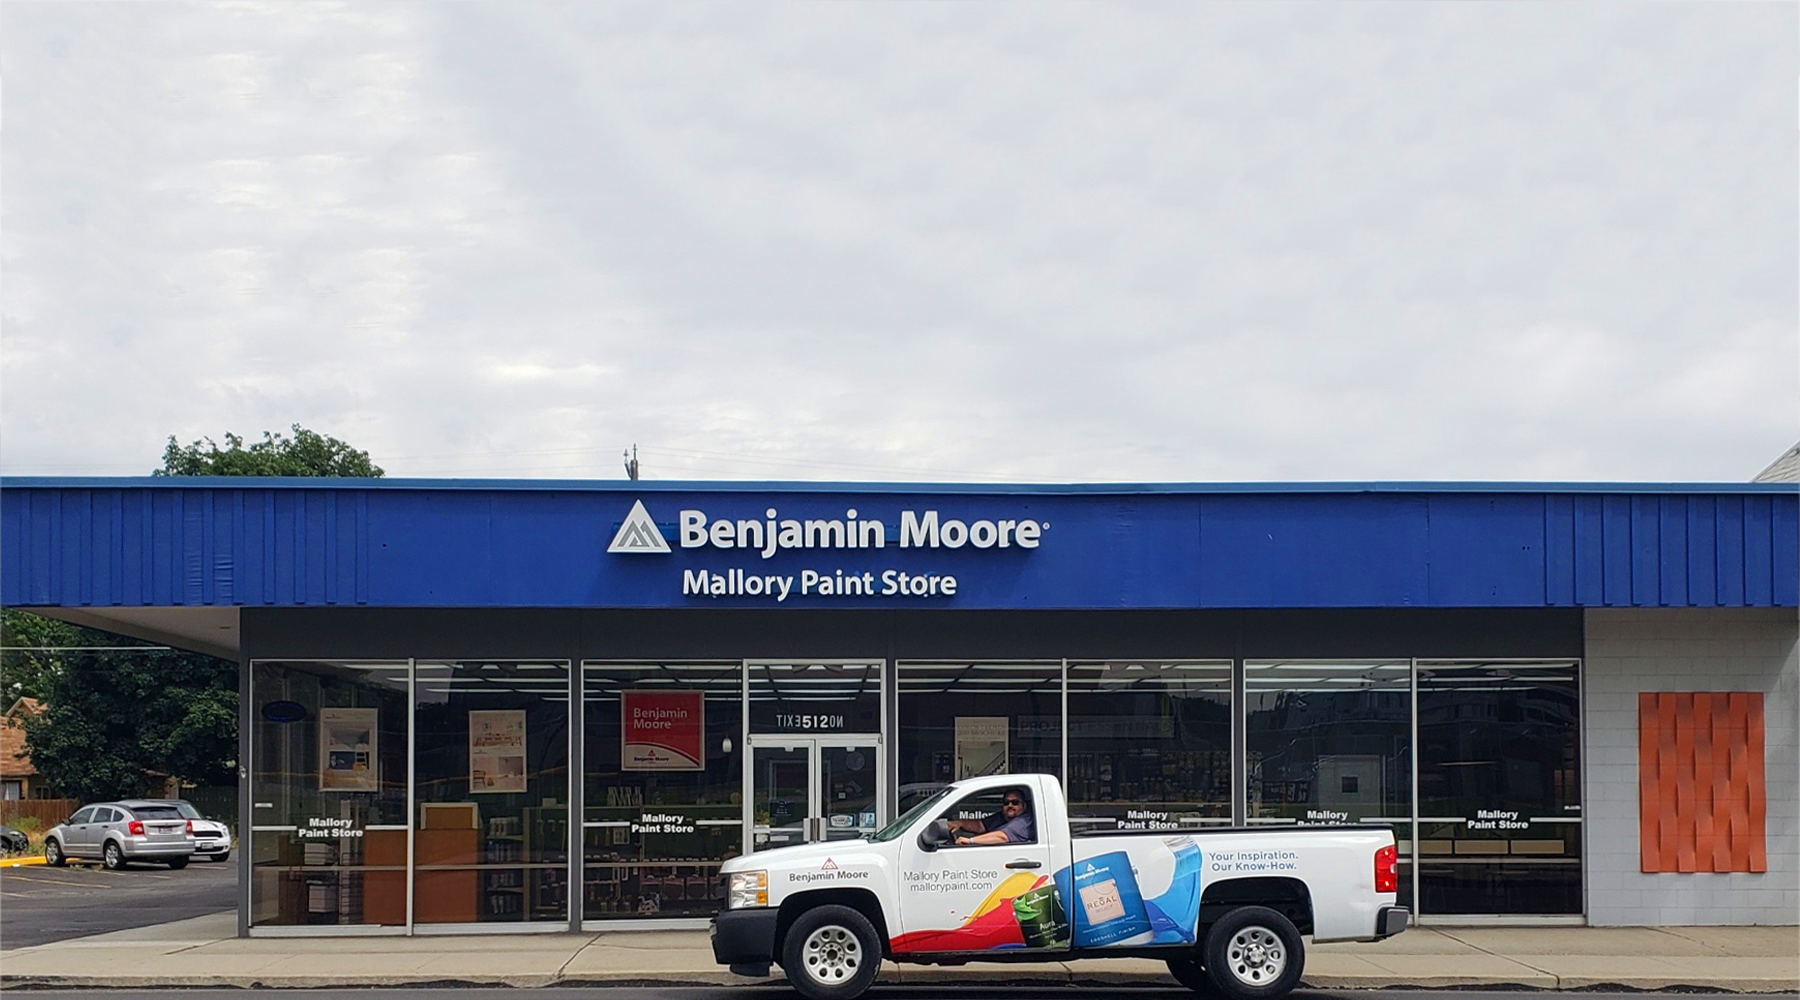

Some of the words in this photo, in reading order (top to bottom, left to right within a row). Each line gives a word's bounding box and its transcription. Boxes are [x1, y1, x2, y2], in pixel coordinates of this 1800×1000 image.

[679, 508, 885, 559] Benjamin
[900, 510, 1041, 549] Moore
[682, 569, 793, 601] Mallory
[801, 569, 875, 595] Paint
[881, 569, 958, 596] Store
[633, 707, 688, 720] Benjamin
[633, 719, 672, 729] Moore
[802, 715, 829, 729] 512
[1020, 720, 1084, 732] PROJCT
[642, 813, 684, 825] Mallory
[959, 810, 995, 820] Mallo
[1127, 810, 1168, 821] Mallory
[1307, 810, 1348, 821] Mallory
[1477, 809, 1519, 821] Mallory
[309, 817, 353, 829] Mallory
[631, 824, 661, 833] Paint
[663, 824, 694, 833] Store
[1117, 820, 1146, 829] Paint
[1148, 820, 1178, 830] Store
[1467, 820, 1496, 829] Paint
[1498, 820, 1529, 829] Store
[298, 828, 329, 838] Paint
[331, 828, 364, 837] Store
[1209, 852, 1234, 861] Your
[1237, 850, 1298, 861] Inspiration.
[1211, 862, 1232, 872] Our
[1235, 861, 1297, 871] Know-How.
[789, 870, 835, 882] Benjamin
[837, 869, 869, 880] Moore
[903, 871, 939, 882] Mallory
[942, 869, 968, 880] Paint
[970, 869, 998, 880] Store
[910, 881, 993, 893] mallorypaint.com
[1087, 896, 1117, 910] REGAL
